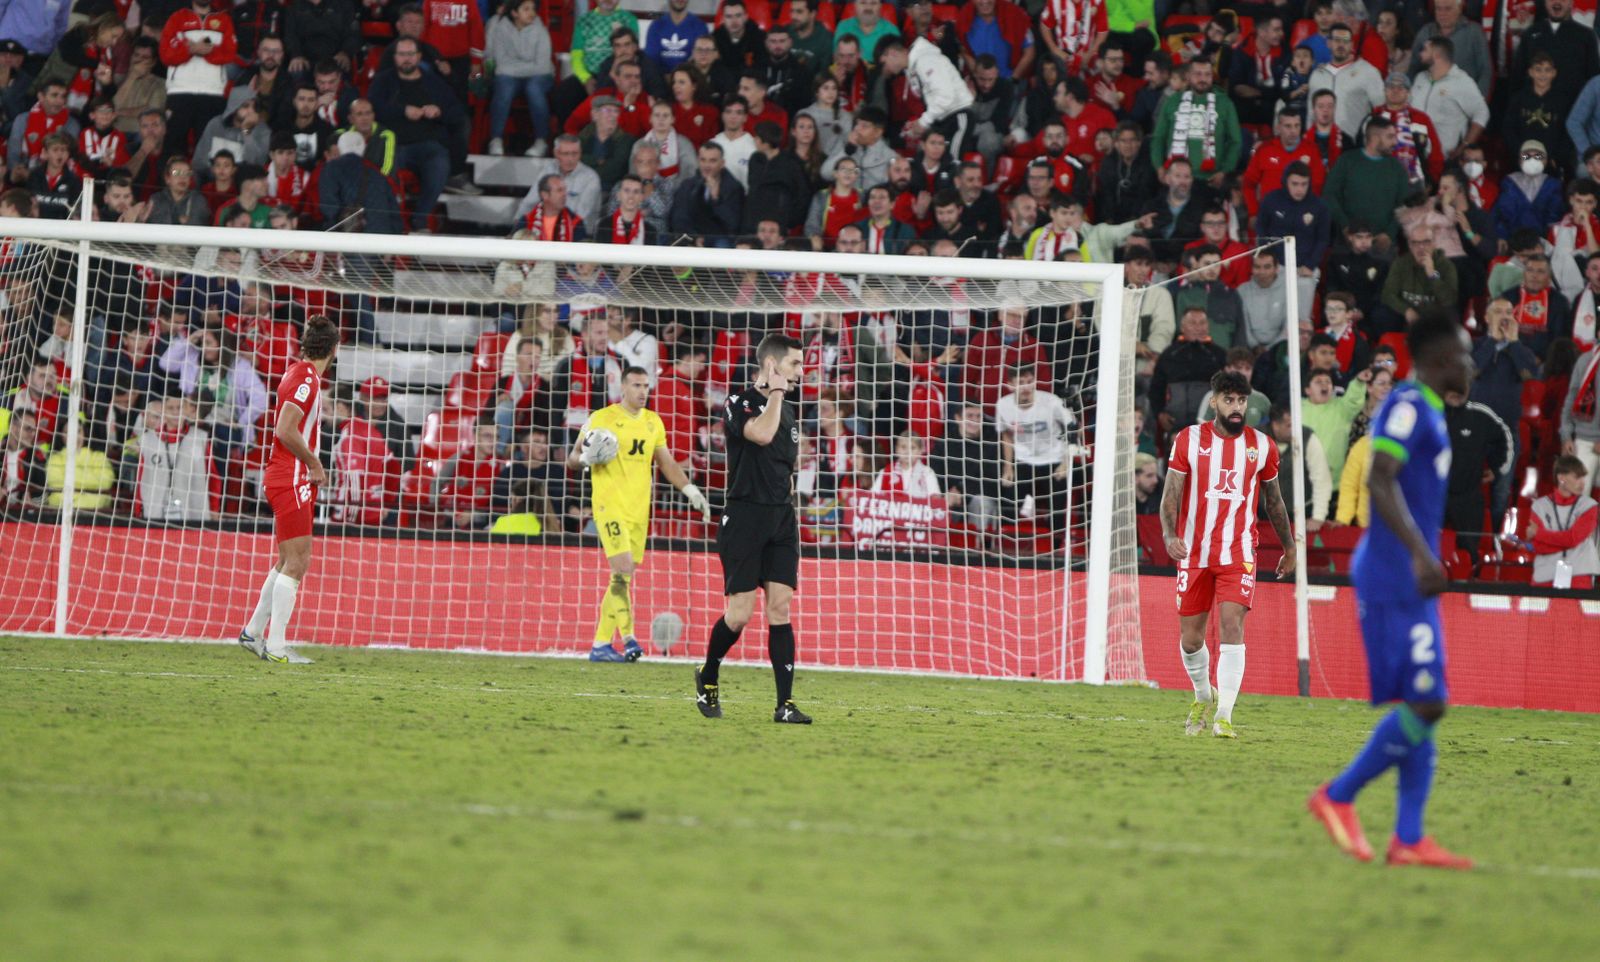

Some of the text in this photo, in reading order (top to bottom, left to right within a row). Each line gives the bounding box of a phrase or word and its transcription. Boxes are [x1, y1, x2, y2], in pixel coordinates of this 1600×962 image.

[628, 439, 646, 455] JK
[1214, 470, 1239, 490] JK
[605, 521, 621, 537] 13
[1410, 623, 1435, 664] 2
